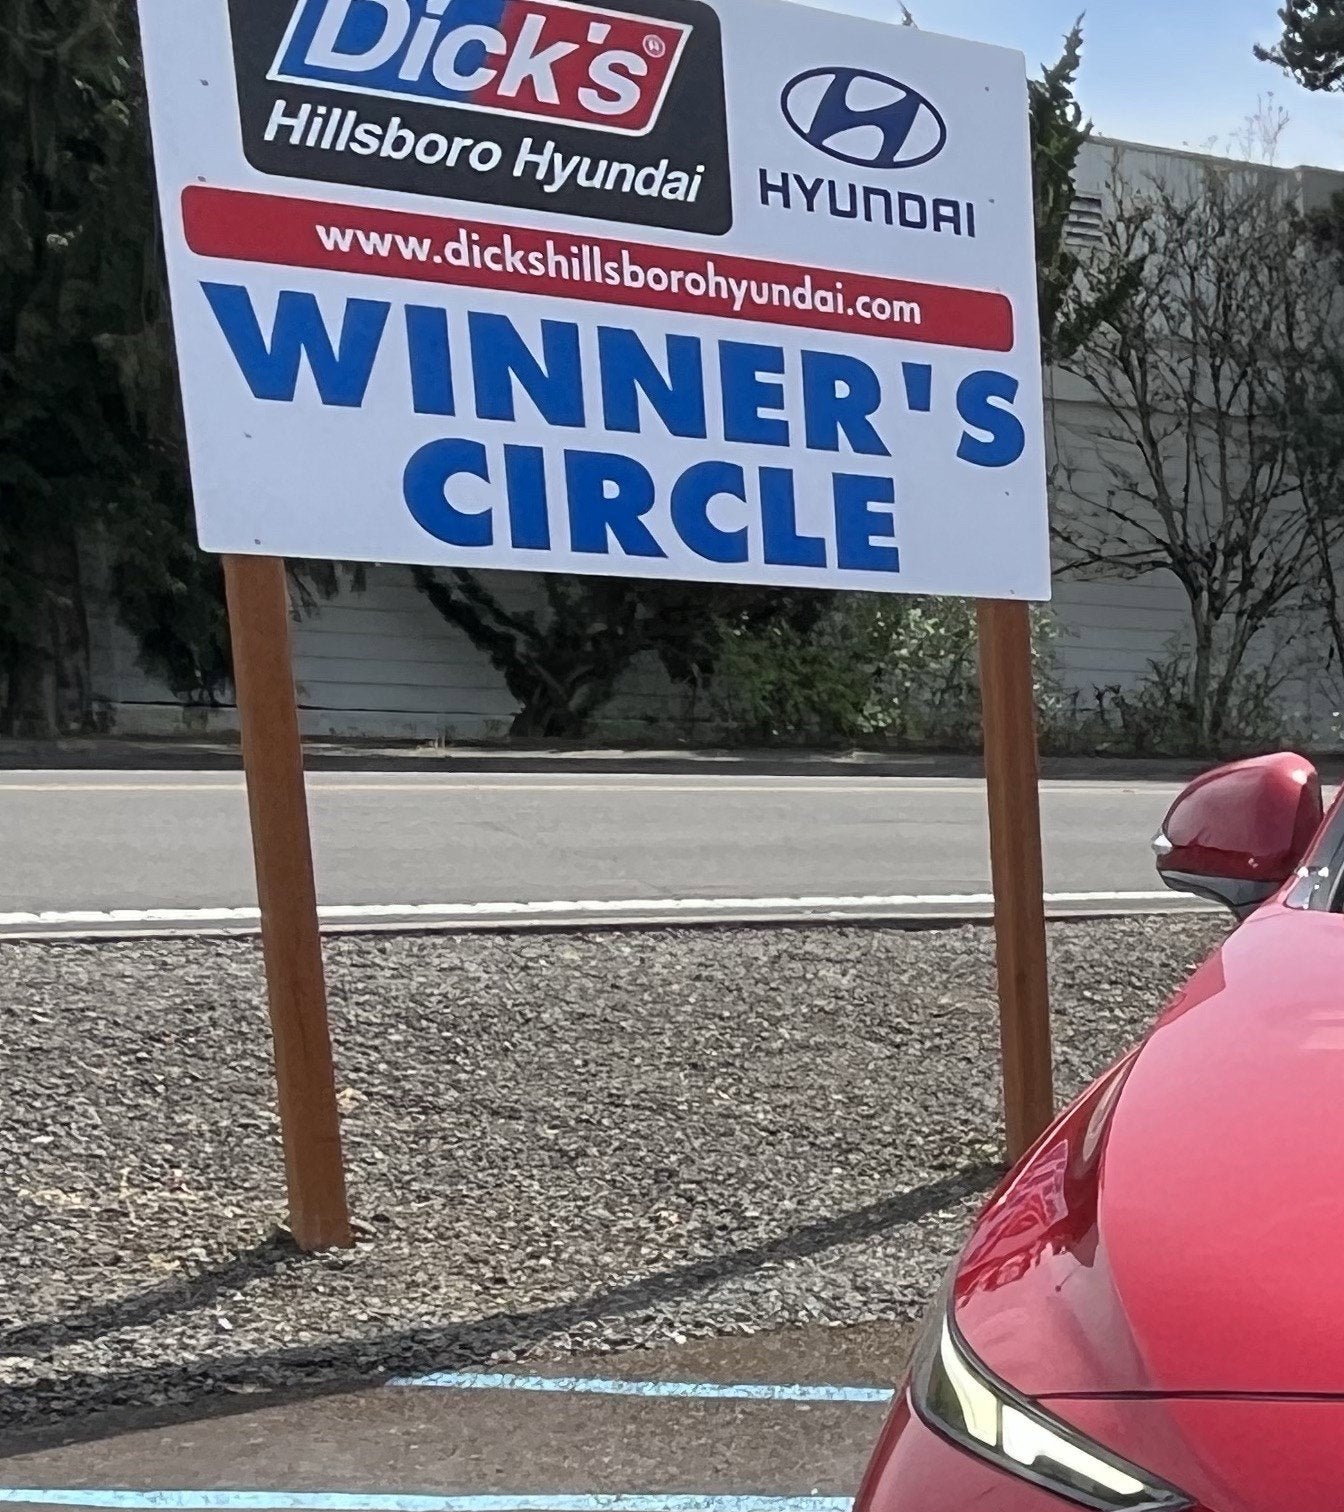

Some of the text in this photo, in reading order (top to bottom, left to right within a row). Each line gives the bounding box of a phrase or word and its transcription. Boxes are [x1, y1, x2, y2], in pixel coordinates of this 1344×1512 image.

[303, 0, 648, 116] Dick's
[263, 99, 706, 202] Hillsboro Hyundai
[758, 168, 976, 238] HYUNDAI
[315, 225, 923, 326] www.dickshillsborohyundai.com
[199, 280, 1026, 468] WINNER'S
[402, 438, 901, 573] CIRCLE
